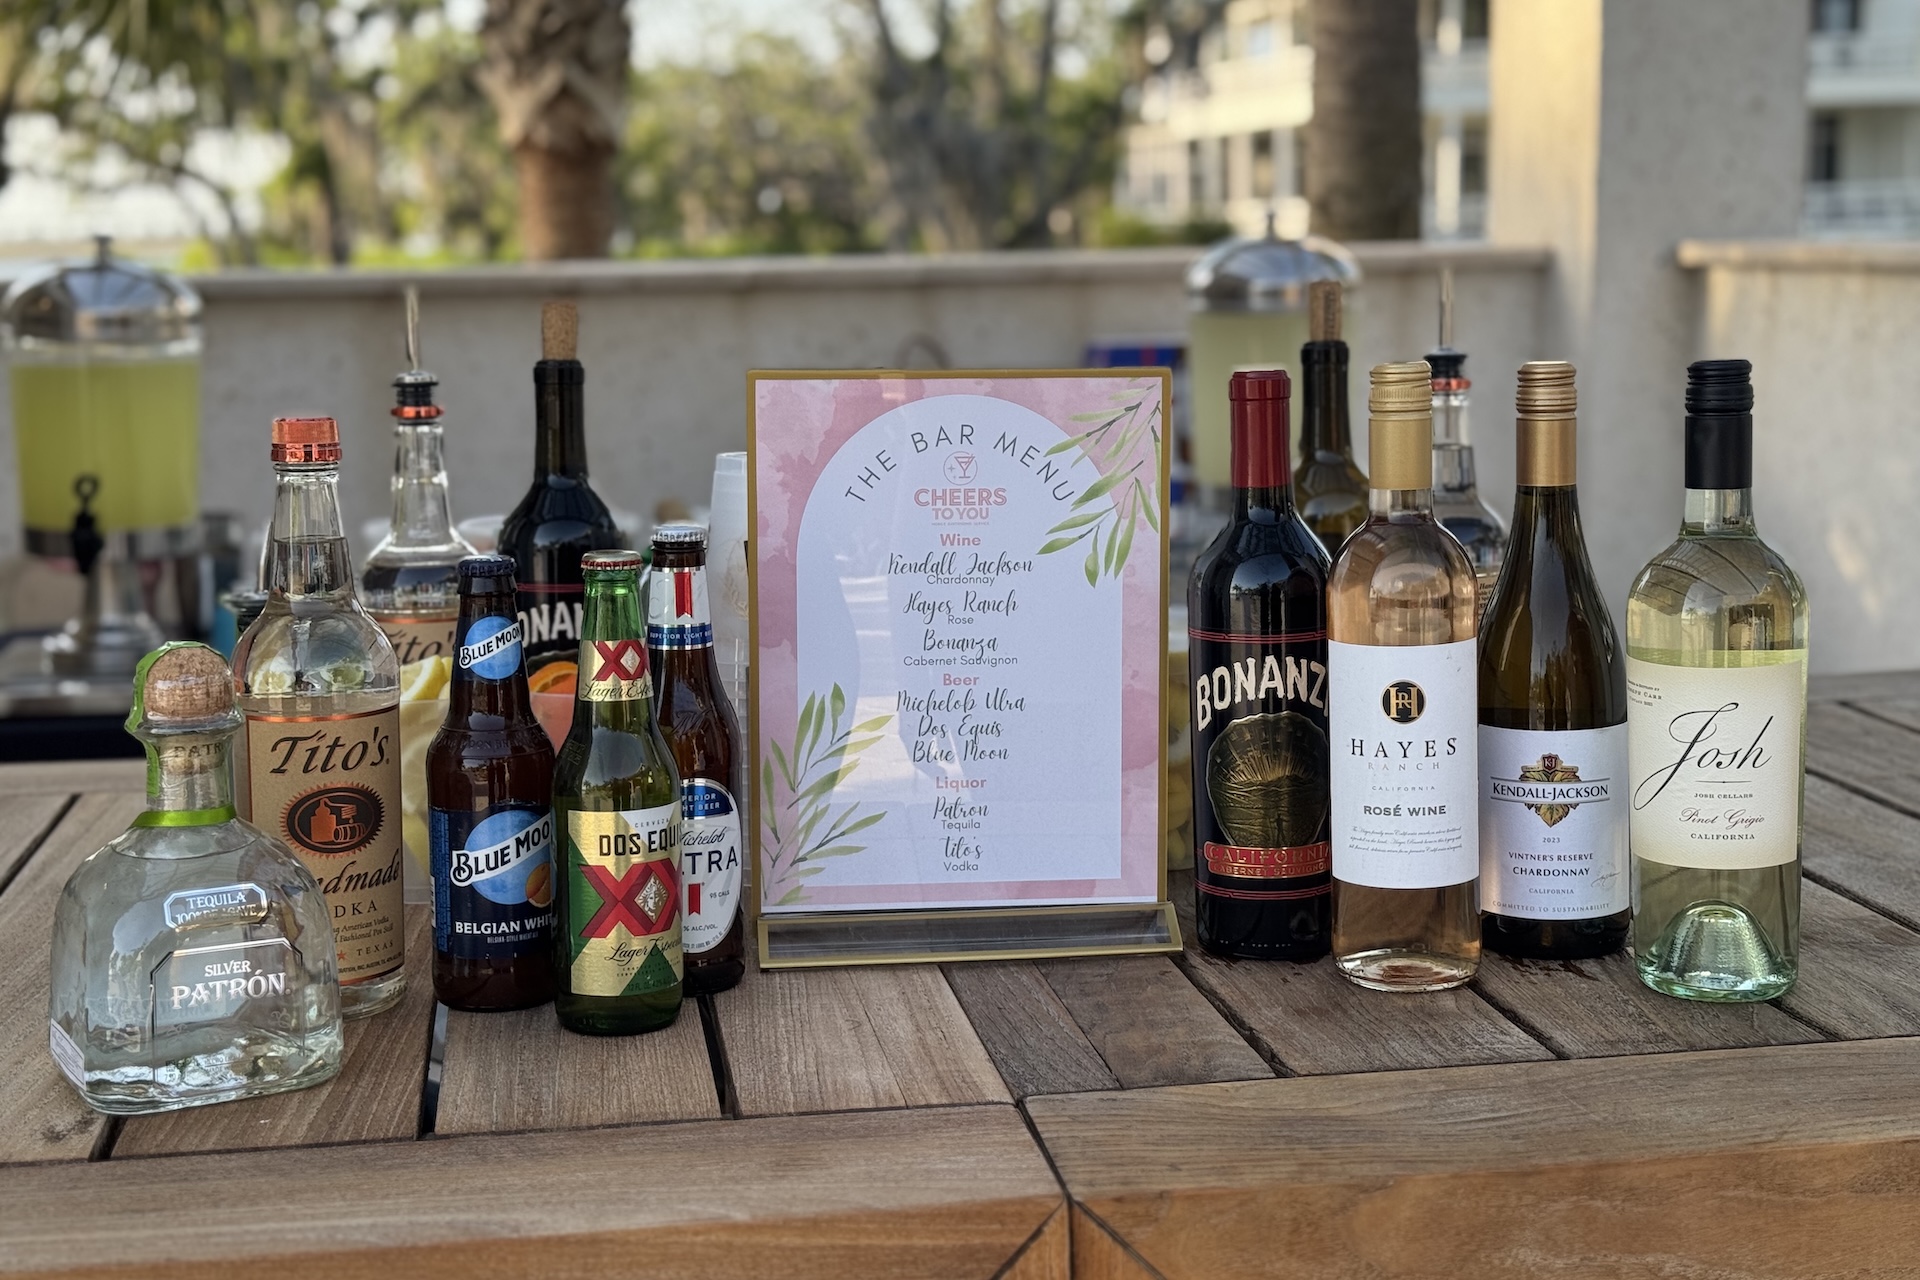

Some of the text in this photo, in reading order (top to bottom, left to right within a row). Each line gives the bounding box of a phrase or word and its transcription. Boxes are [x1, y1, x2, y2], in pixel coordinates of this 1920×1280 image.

[844, 424, 1074, 502] THE BAR MENU
[914, 487, 1007, 507] CHEERS
[932, 507, 989, 520] TO YOU
[940, 533, 981, 547] Wine
[888, 551, 1034, 576] Kendall Jackson
[926, 574, 995, 587] Chardonnay
[903, 589, 1019, 625] Hayes Ranch
[947, 614, 974, 625] Rose
[650, 632, 680, 640] SUPERIOR
[683, 632, 703, 640] LIGHT
[461, 642, 494, 667] BLUE
[923, 628, 998, 663] Bonanza
[903, 655, 1018, 668] Cabernet Sauvignon
[943, 673, 980, 686] Beer
[896, 689, 977, 715] Michelob
[1196, 655, 1328, 732] BONANZ
[918, 714, 1004, 744] Dos Equis
[270, 726, 389, 774] Tito's
[913, 739, 1009, 763] Blue Moon
[1351, 737, 1457, 759] HAYES
[1633, 702, 1774, 811] Josh
[1368, 762, 1440, 771] RANCH
[936, 776, 987, 793] Liquor
[1493, 781, 1608, 801] KENDALL-JACKSON
[682, 793, 717, 802] PERIOR
[698, 802, 721, 811] BEER
[933, 796, 989, 819] Patron
[1363, 804, 1446, 817] ROSÉ WINE
[1679, 807, 1718, 825] Pinot
[941, 819, 981, 832] Tequila
[599, 823, 681, 857] DOS EQUI
[1690, 833, 1756, 841] CALIFORNIA
[452, 820, 551, 882] BLUE MOO
[1508, 851, 1594, 862] VINTNER'S RESERVE
[682, 846, 738, 875] TRA
[943, 861, 979, 872] Vodka
[317, 848, 400, 894] dmade
[1512, 866, 1590, 877] CHARDONNAY
[186, 892, 247, 909] TEQUILA
[334, 900, 377, 918] DKA
[1492, 900, 1535, 913] COMMITTED
[1552, 902, 1610, 913] SUSTAINABILITY
[455, 920, 520, 934] BELGIAN
[356, 940, 393, 956] TEXAS
[604, 942, 647, 966] Lager
[205, 960, 252, 977] SILVER
[171, 970, 286, 1010] PATRÓN
